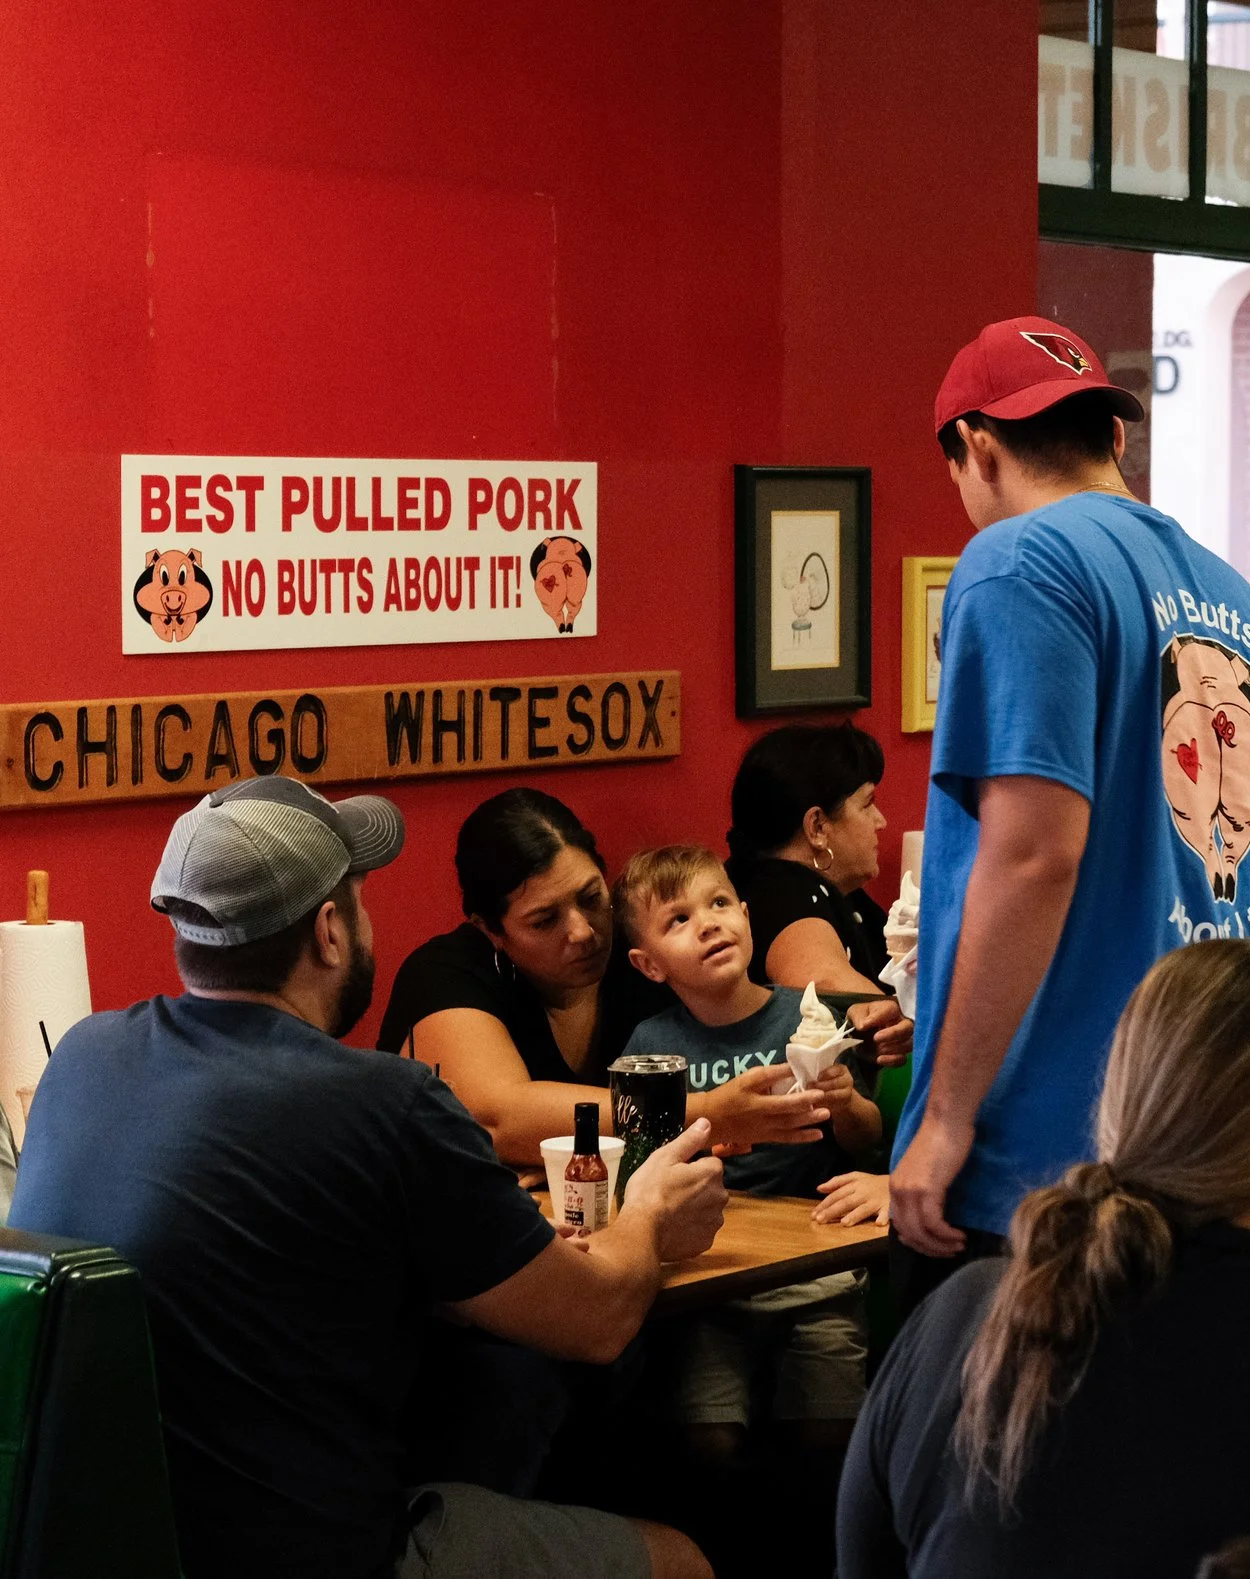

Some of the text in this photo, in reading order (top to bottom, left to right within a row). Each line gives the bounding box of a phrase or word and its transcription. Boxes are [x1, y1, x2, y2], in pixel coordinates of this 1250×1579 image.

[140, 473, 583, 535] BEST PULLED PORK
[221, 555, 522, 618] NO BUTTS ABOUT IT!
[1152, 591, 1178, 632] No
[24, 679, 665, 792] CHICAGO WHITESOX
[689, 1050, 777, 1089] UCKY
